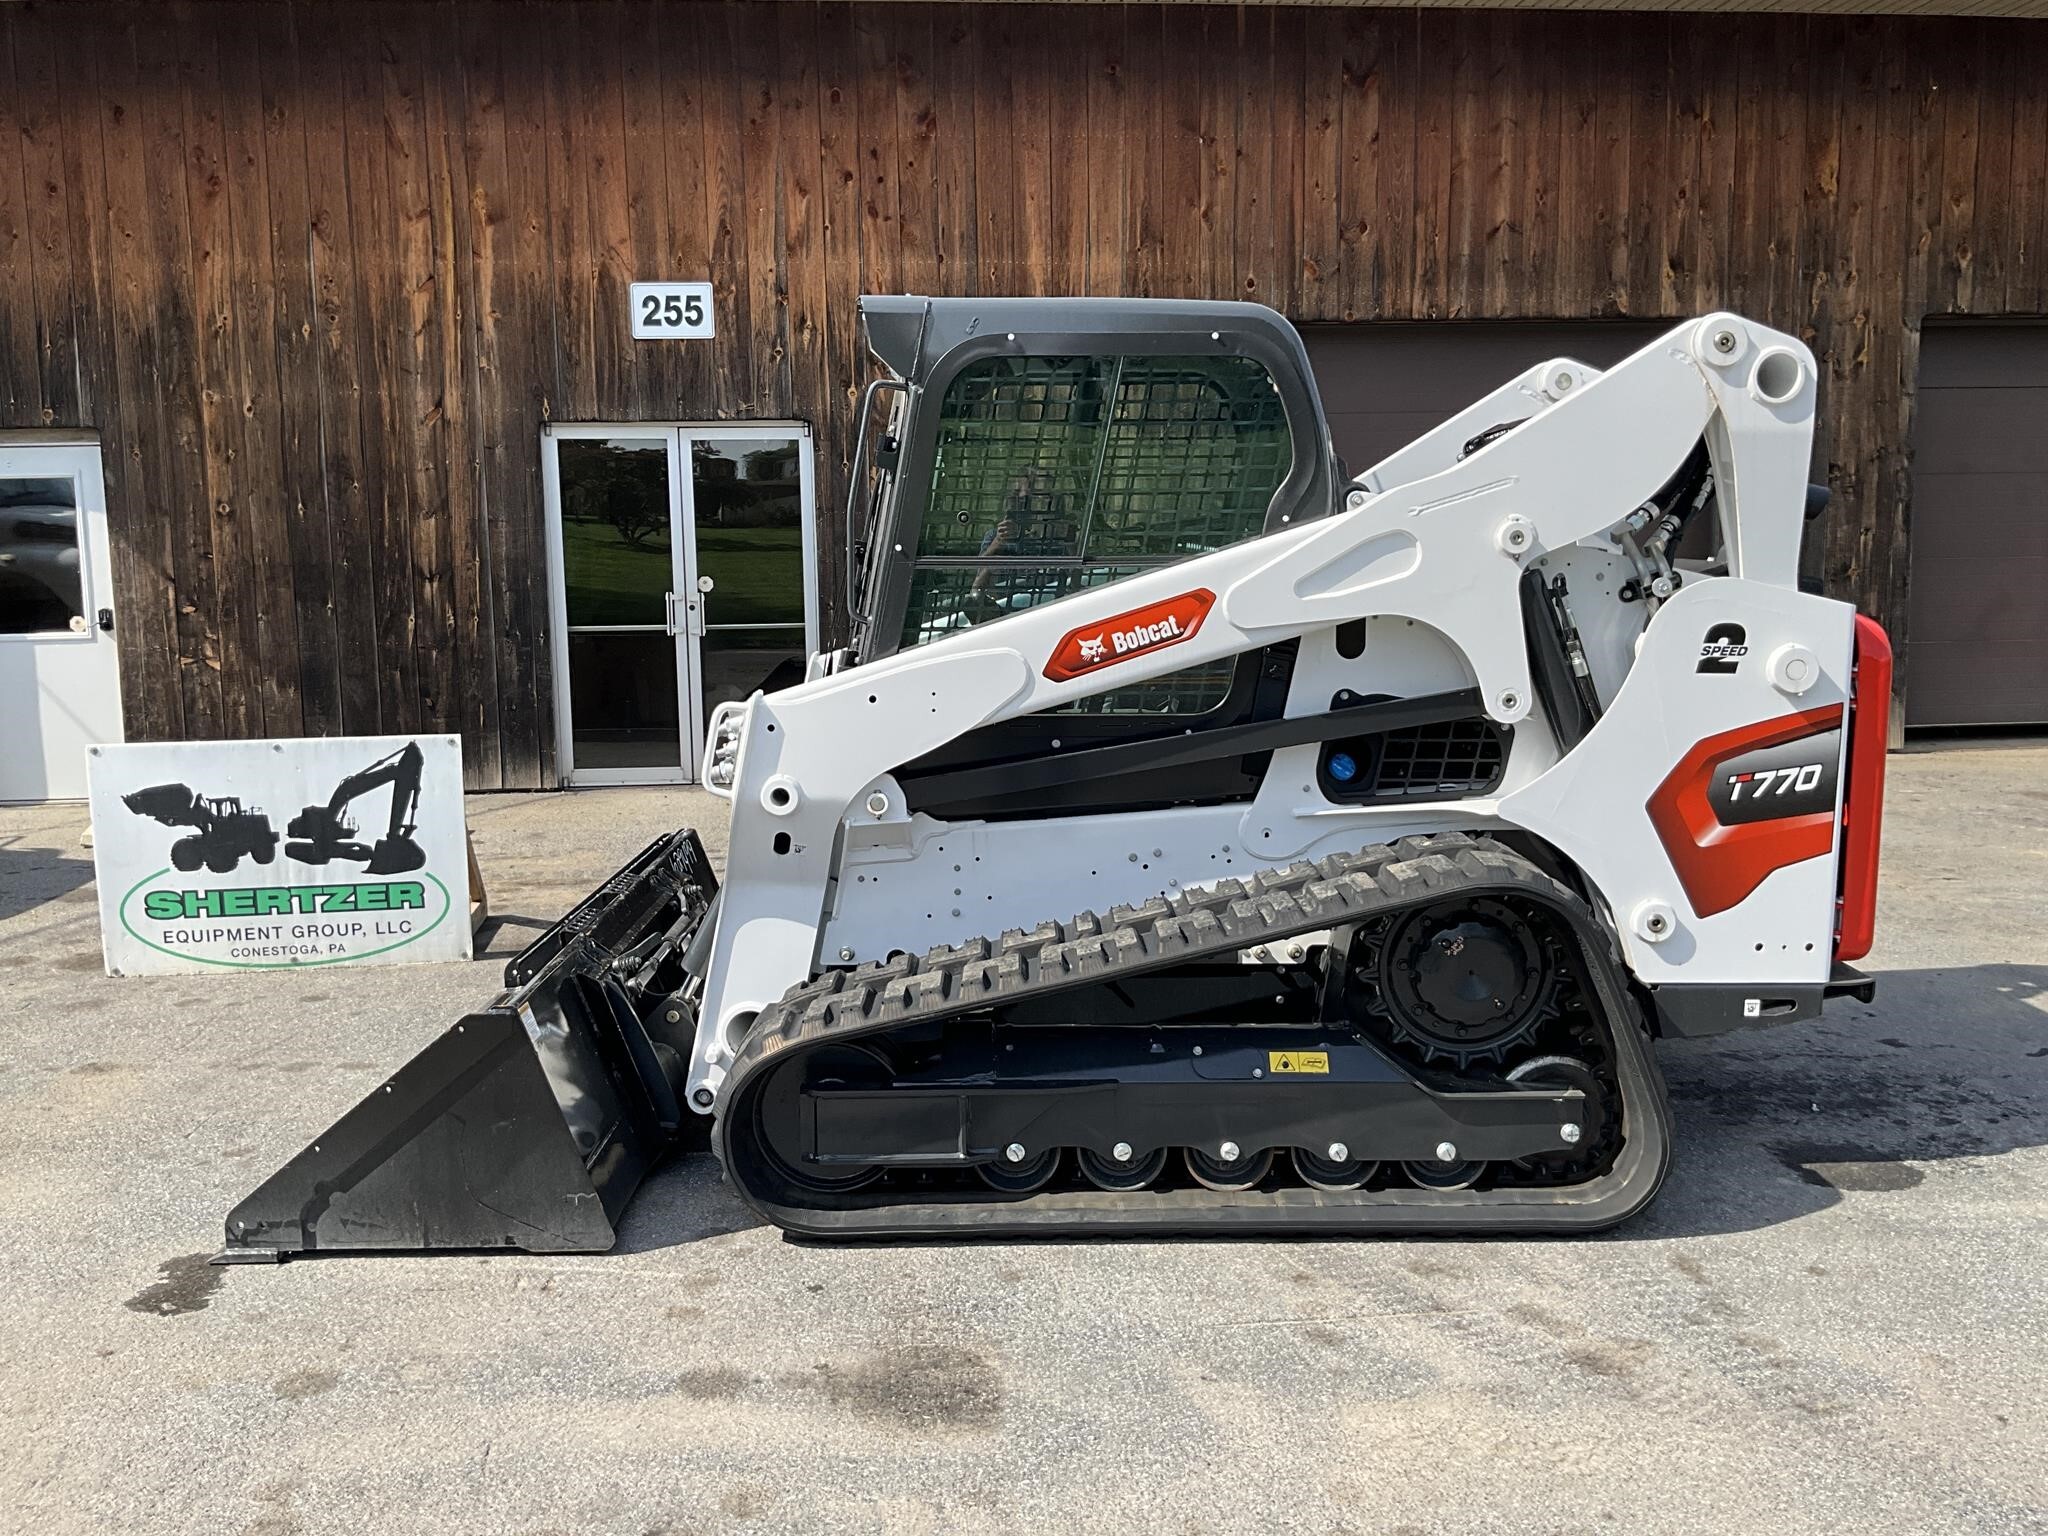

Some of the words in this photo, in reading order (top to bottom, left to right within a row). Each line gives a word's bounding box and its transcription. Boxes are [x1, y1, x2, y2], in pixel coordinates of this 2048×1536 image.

[642, 295, 704, 327] 255
[1111, 615, 1181, 654] Bobcat
[1695, 622, 1747, 674] 2
[1700, 645, 1748, 657] SPEED
[1728, 763, 1823, 801] T770
[144, 881, 425, 920] SHERTZER
[163, 926, 283, 944] EQUIPMENT
[292, 922, 367, 939] GROUP,
[375, 920, 412, 935] LLC
[231, 945, 323, 958] CONESTOGA,
[329, 943, 346, 953] PA
